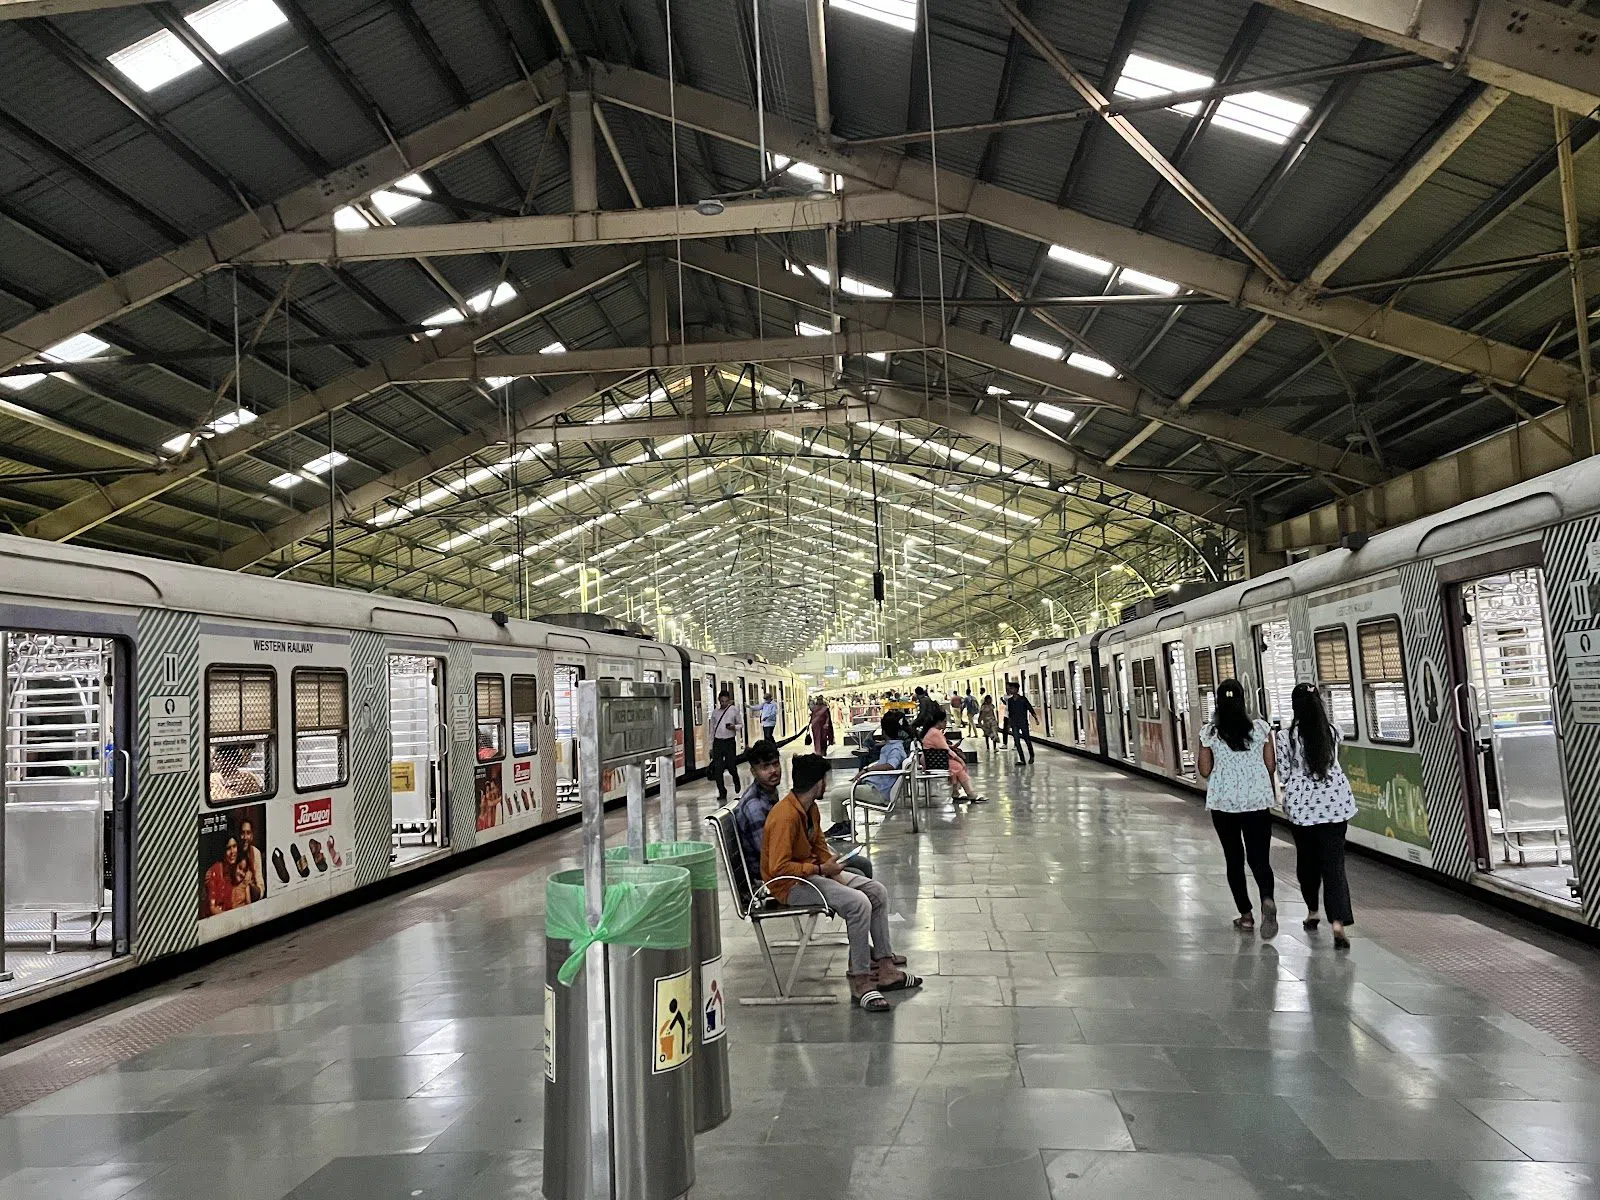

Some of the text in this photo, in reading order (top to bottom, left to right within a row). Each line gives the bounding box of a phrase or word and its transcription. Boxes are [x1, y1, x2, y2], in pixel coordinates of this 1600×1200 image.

[253, 639, 314, 654] WESTERN RAILWAY
[297, 804, 330, 825] Paragon
